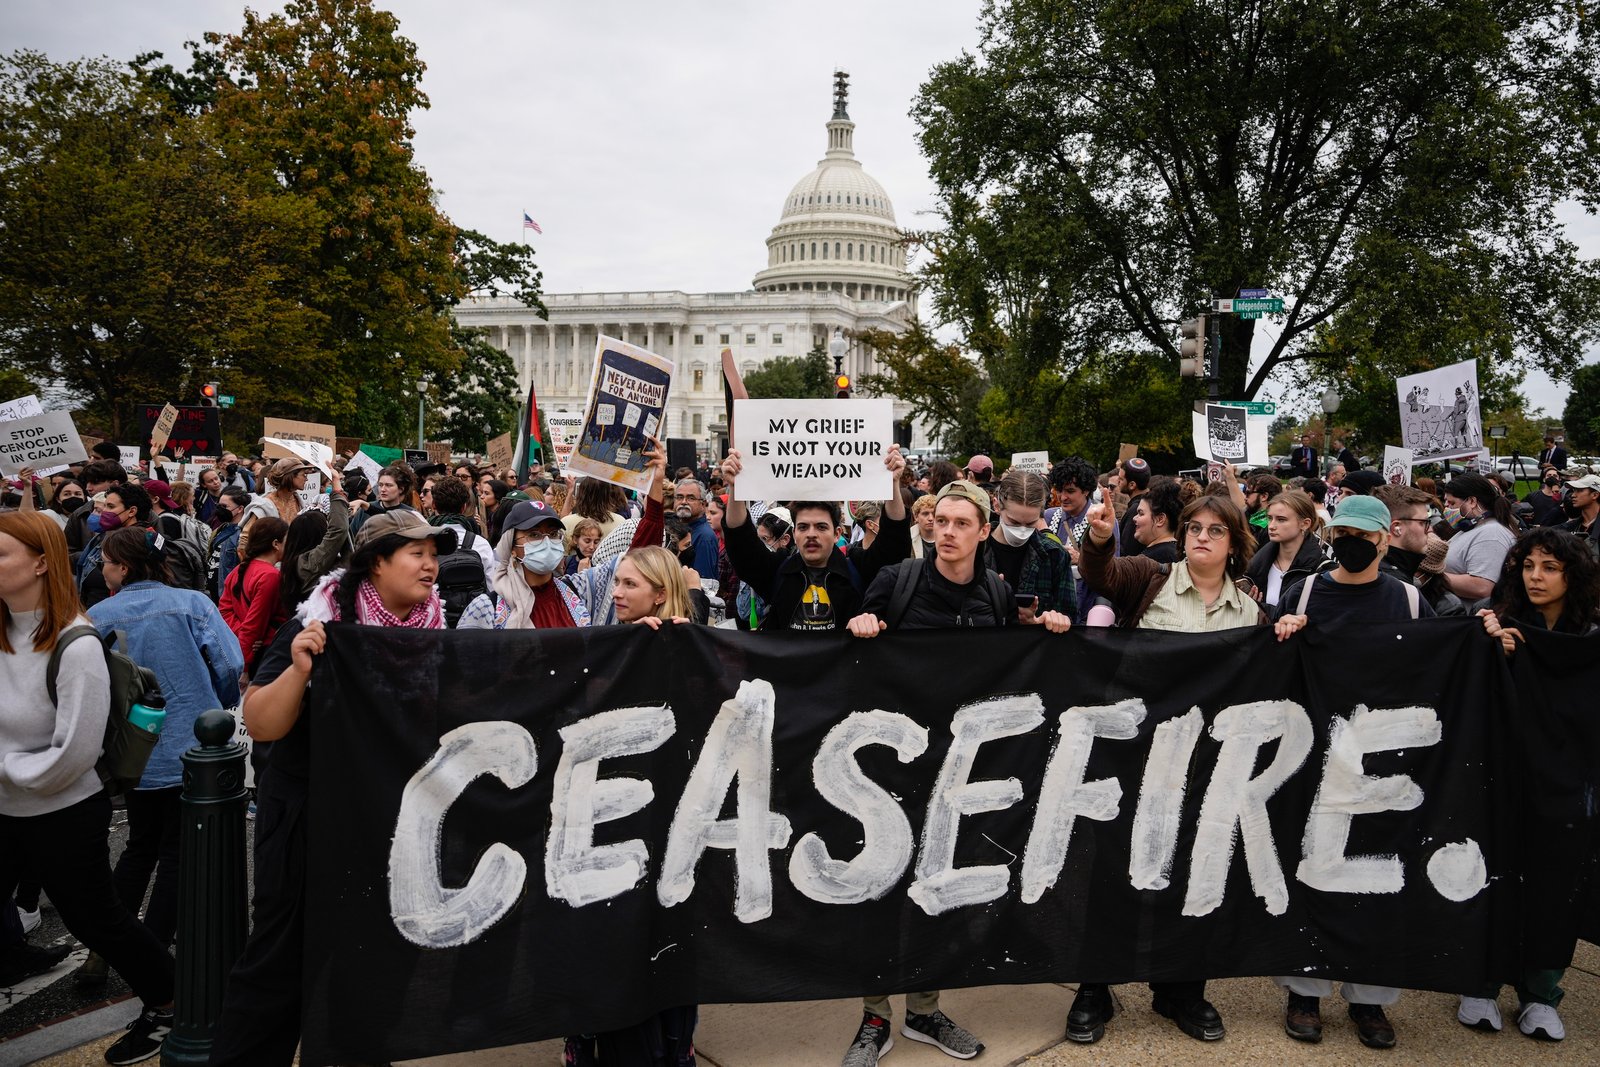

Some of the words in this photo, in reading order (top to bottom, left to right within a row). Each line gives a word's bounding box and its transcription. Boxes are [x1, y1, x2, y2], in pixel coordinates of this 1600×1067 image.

[1236, 301, 1273, 311] Independence
[607, 370, 637, 391] NEVER
[637, 382, 661, 399] AGAIN
[608, 384, 624, 398] FOR
[627, 391, 657, 406] ANYONE
[146, 408, 207, 421] PATINE
[549, 418, 582, 426] CONGRESS
[10, 427, 45, 441] STOP
[769, 418, 799, 434] MY
[805, 418, 865, 434] GRIEF
[1407, 420, 1456, 445] GAZA
[0, 433, 69, 454] GENOCIDE
[752, 441, 770, 456] IS
[777, 441, 819, 456] NOT
[825, 441, 881, 456] YOUR
[10, 453, 24, 464] IN
[27, 446, 67, 461] GAZA
[771, 463, 862, 478] WEAPON
[387, 678, 1490, 950] CEASEFIRE.
